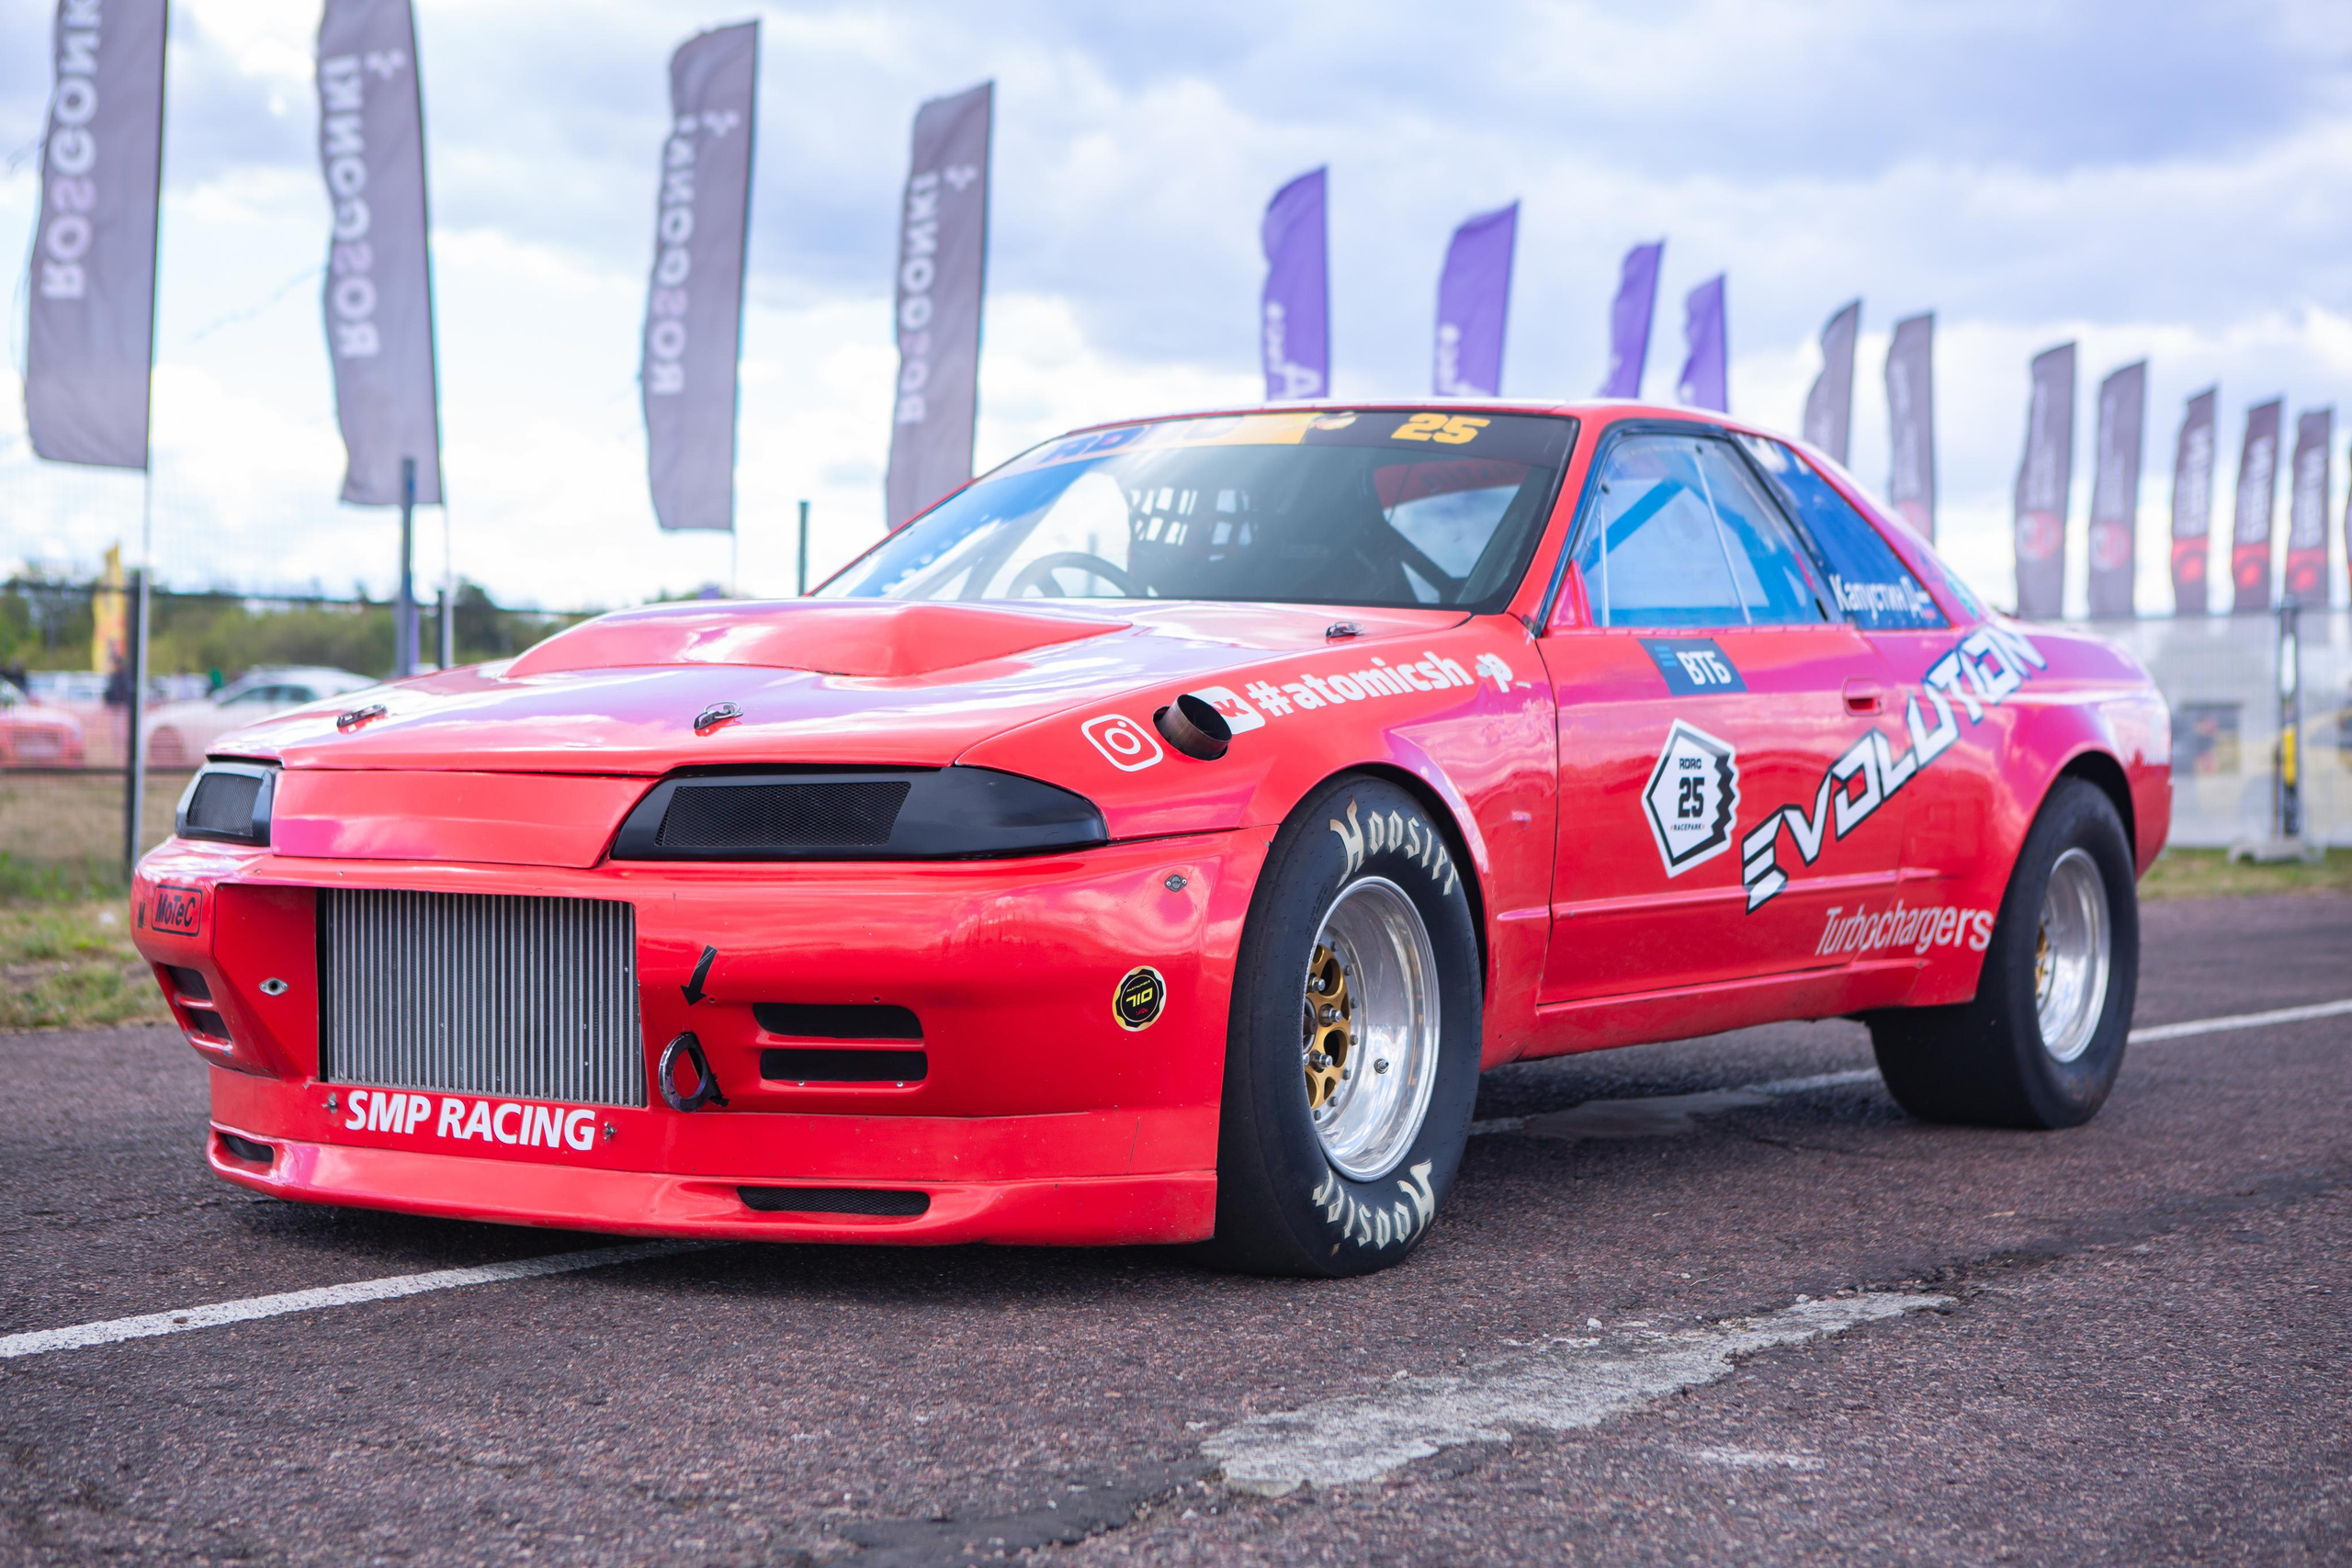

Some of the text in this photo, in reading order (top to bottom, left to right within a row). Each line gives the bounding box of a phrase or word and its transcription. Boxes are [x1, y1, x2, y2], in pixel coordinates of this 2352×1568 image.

[1391, 412, 1491, 445] 25
[1676, 650, 1732, 685] ВТБ
[1679, 758, 1702, 770] RDRC
[1742, 625, 2048, 917] EVOLUTION
[1678, 777, 1705, 818] 25
[154, 893, 197, 928] MoTeC
[1815, 898, 1995, 956] Turbochargers
[345, 1090, 596, 1151] SMP RACING
